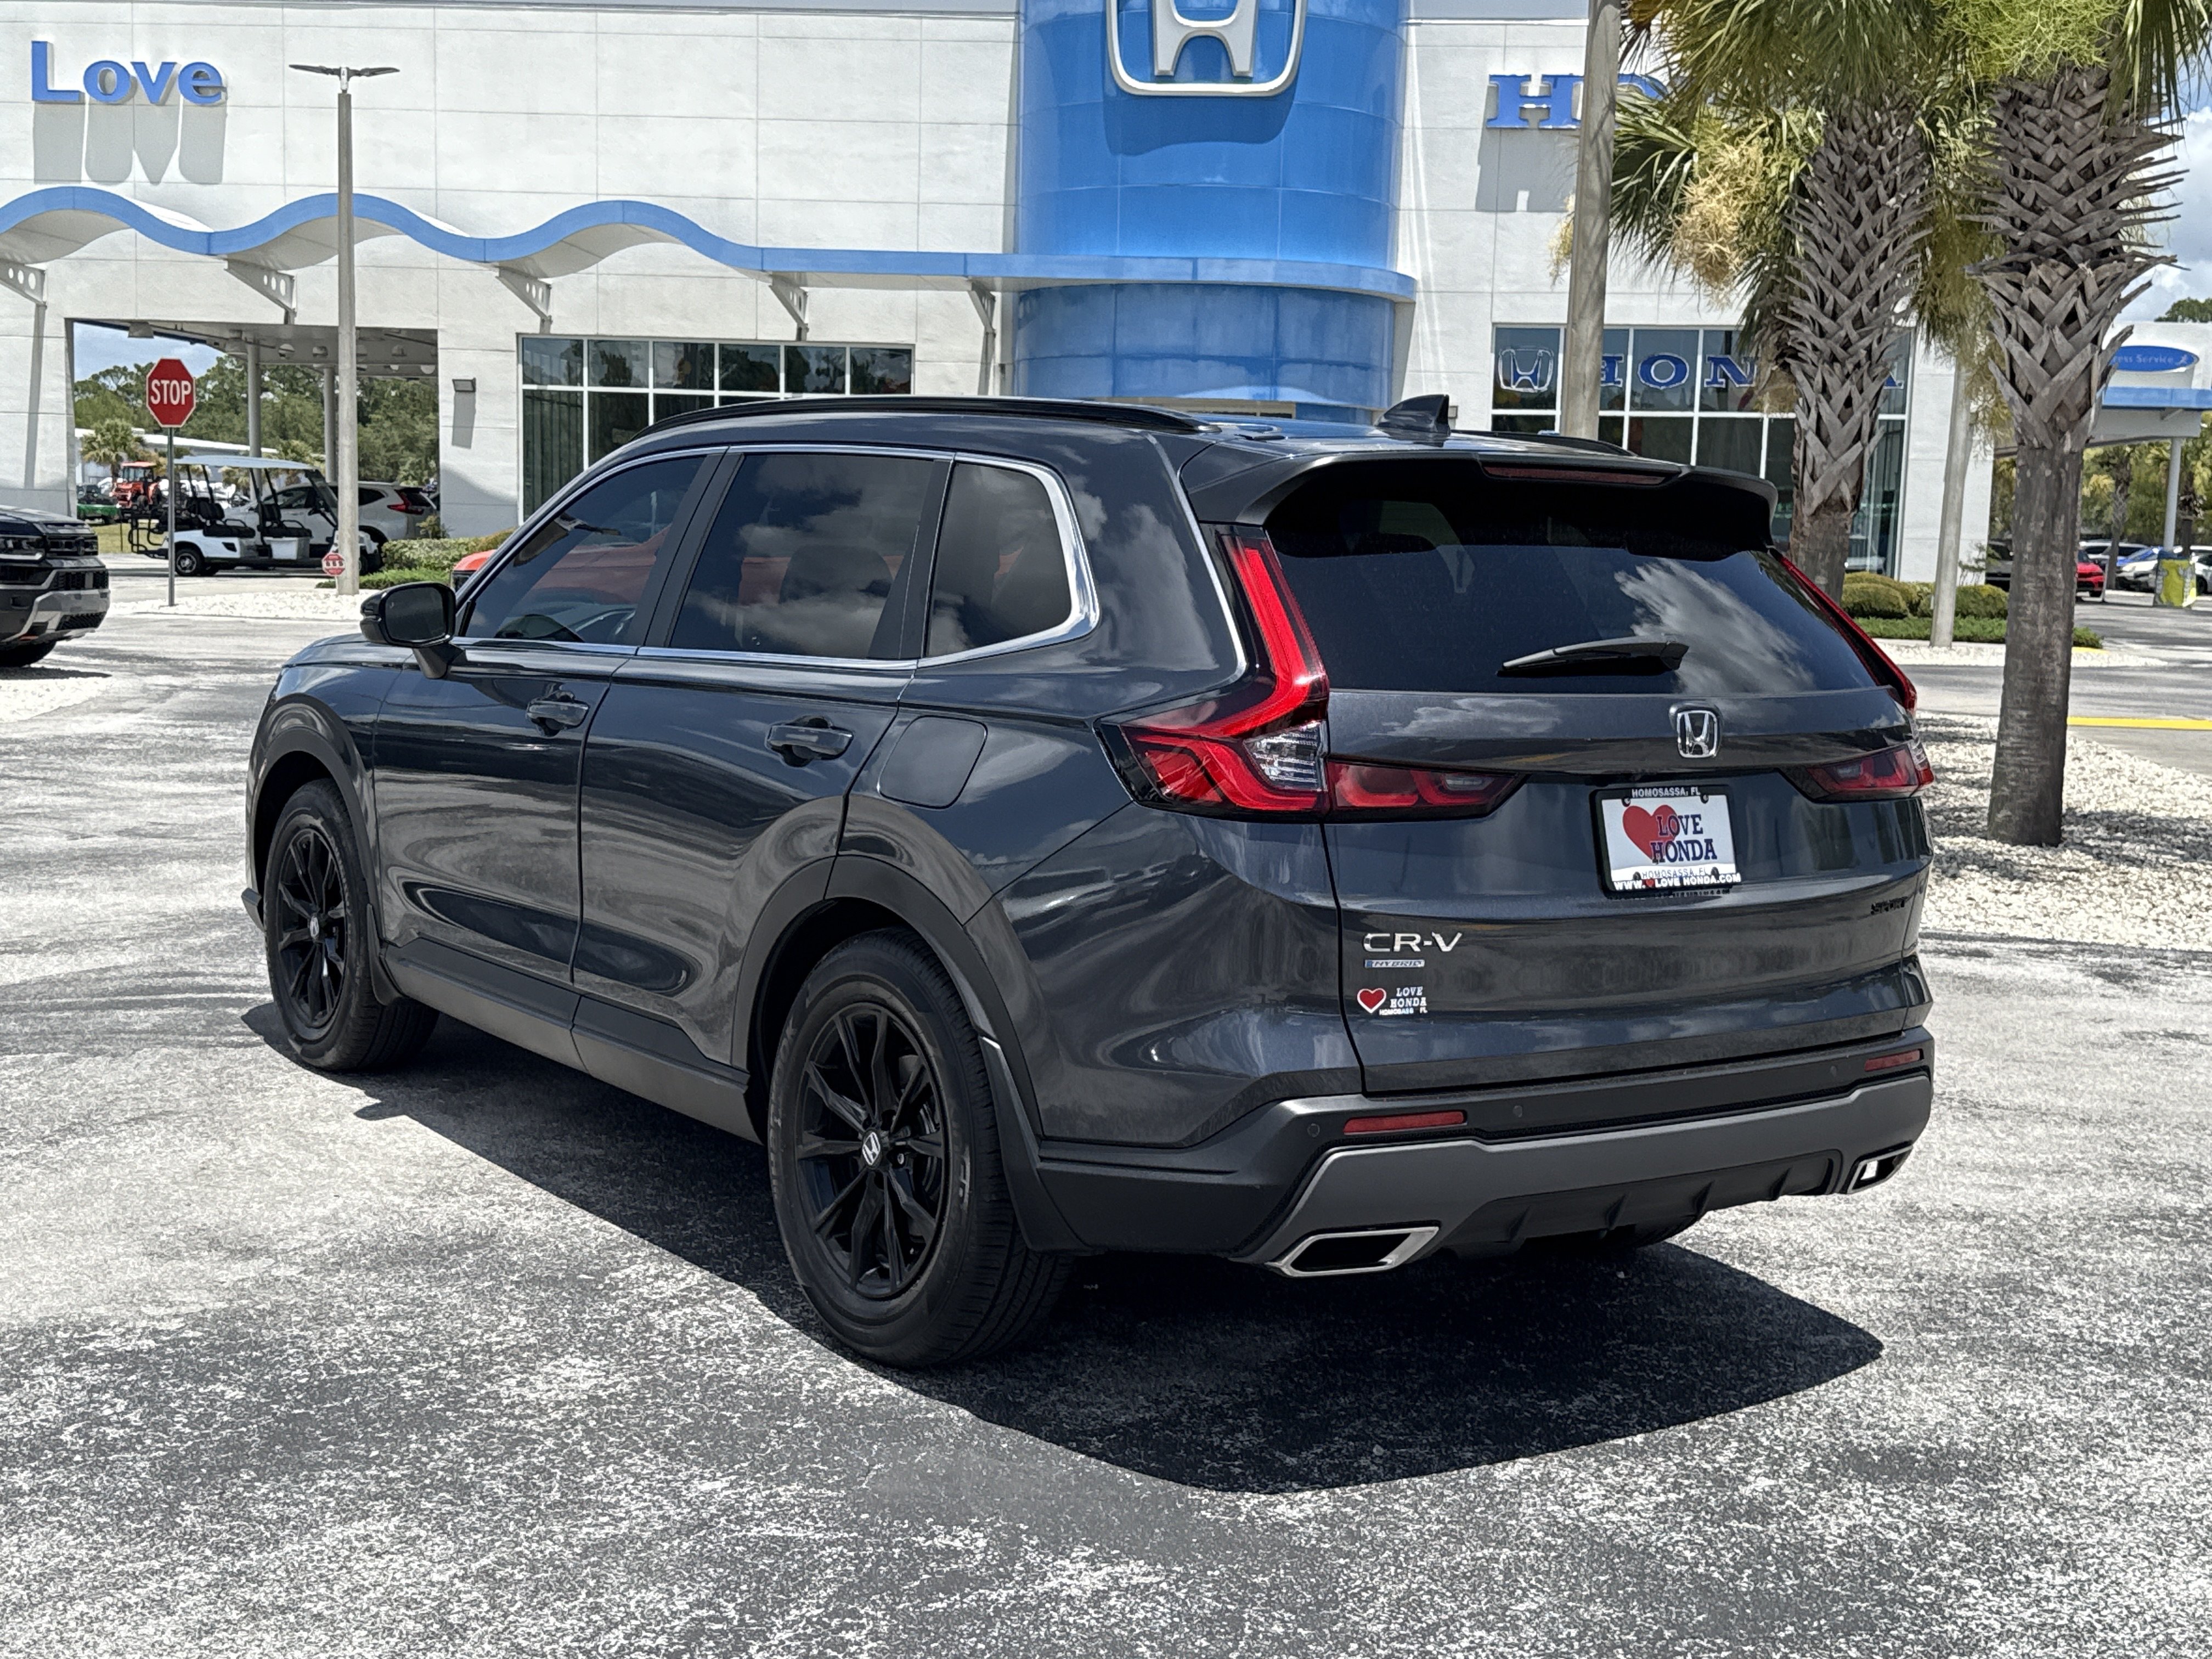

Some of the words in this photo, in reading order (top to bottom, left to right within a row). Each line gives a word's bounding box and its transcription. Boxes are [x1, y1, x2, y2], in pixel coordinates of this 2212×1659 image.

[31, 40, 225, 105] Love
[150, 379, 191, 405] STOP
[1690, 786, 1701, 795] FL
[1656, 814, 1703, 837] LOVE
[1650, 838, 1718, 863] HONDA
[1683, 872, 1741, 885] HONDA.COM
[1699, 867, 1708, 875] FL
[1363, 932, 1463, 952] CR-V
[1396, 986, 1423, 996] LOVE
[1390, 997, 1427, 1008] HONDA
